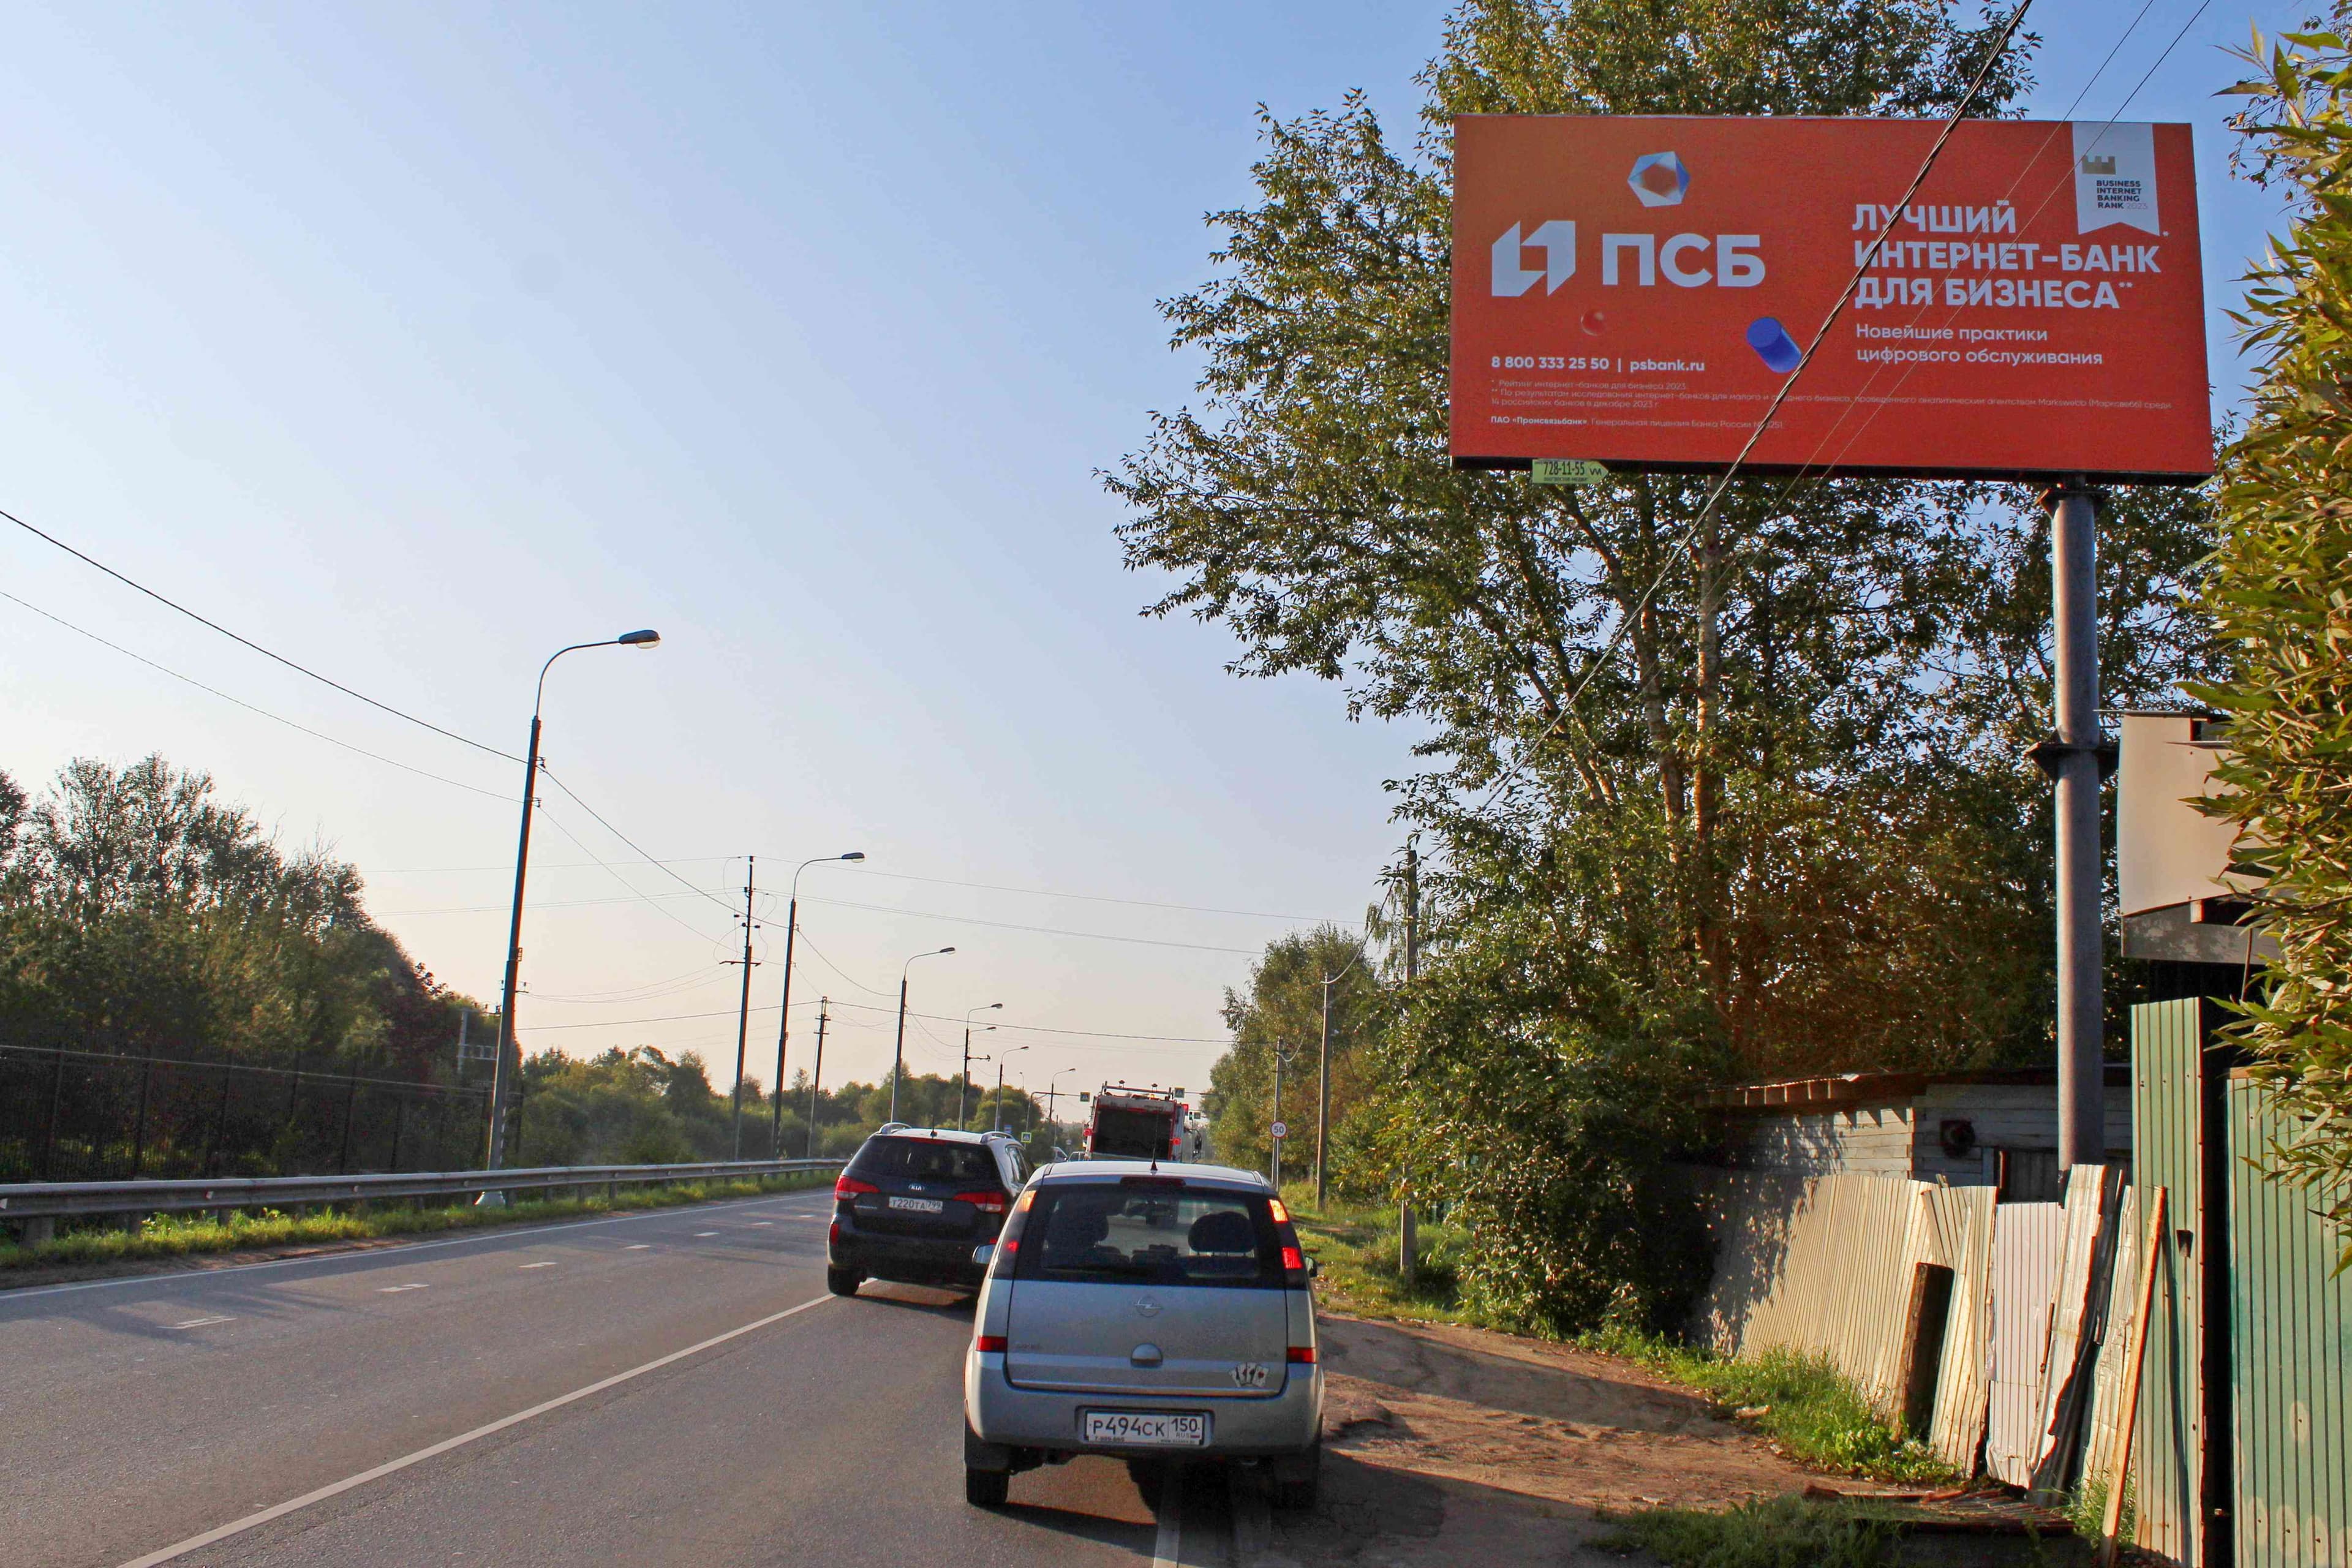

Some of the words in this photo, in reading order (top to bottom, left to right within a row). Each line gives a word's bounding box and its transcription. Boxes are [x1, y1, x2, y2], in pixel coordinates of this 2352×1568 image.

[1852, 200, 2016, 233] ЛУЧШИЙ
[1602, 233, 1766, 288] ПСБ
[1855, 240, 2161, 273] ИНТЕРНЕТ-БАНК
[1855, 277, 1932, 309] ДЛЯ
[1856, 323, 1954, 339] Новейшие
[1959, 328, 2048, 344] практики
[1491, 356, 1500, 368] 8
[1504, 356, 1534, 369] 800
[1539, 356, 1565, 369] 333
[1569, 357, 1586, 369] 25
[1590, 357, 1609, 369] 50
[1630, 359, 1705, 372] psbank.ru
[1856, 347, 1960, 364] цифрового
[1966, 348, 2103, 367] обслуживания
[1544, 460, 1585, 475] 728-11-55
[1093, 1417, 1165, 1436] Р494СК
[1171, 1417, 1198, 1432] 150
